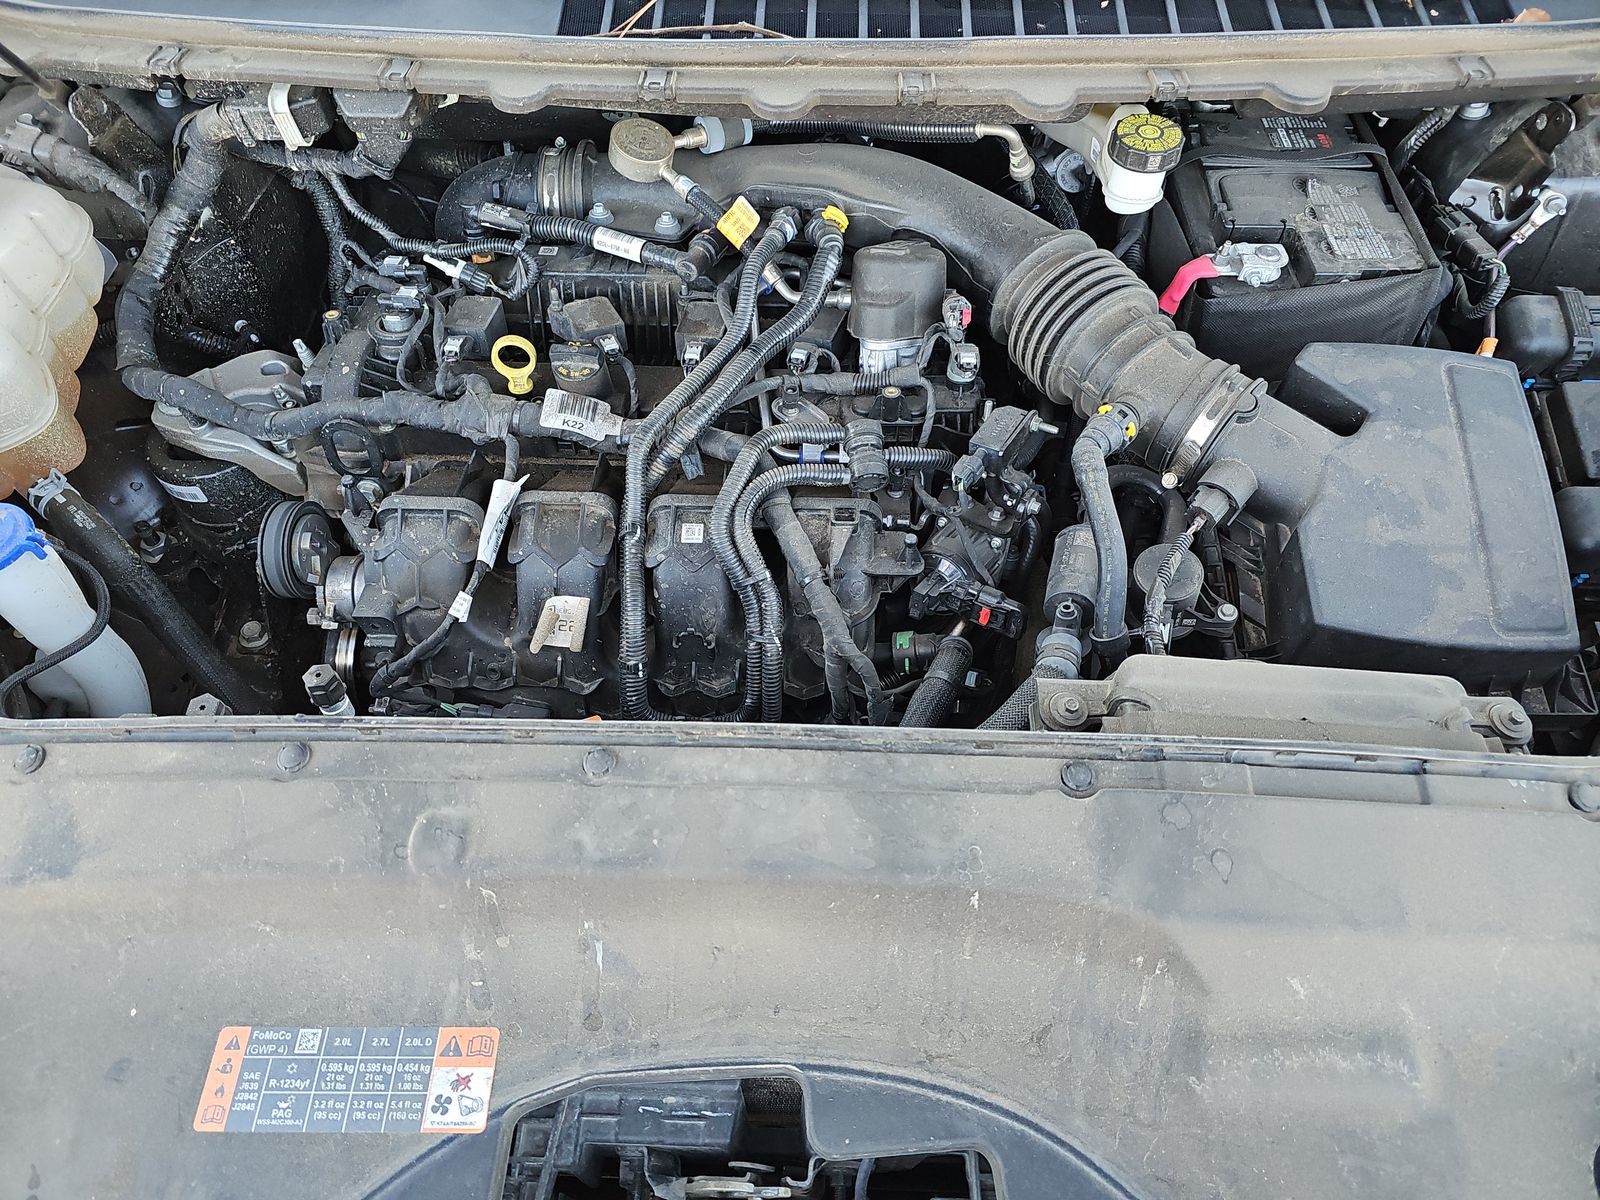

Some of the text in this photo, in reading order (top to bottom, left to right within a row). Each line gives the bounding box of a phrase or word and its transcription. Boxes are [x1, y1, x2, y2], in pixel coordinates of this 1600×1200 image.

[562, 418, 585, 431] K22
[252, 1030, 292, 1041] FoMoCo
[334, 1037, 352, 1046] 2.0L
[372, 1037, 390, 1046] 2.7L
[405, 1037, 432, 1046] 2.0L D
[246, 1044, 288, 1055] (GWP 4)
[321, 1063, 355, 1074] 0.595 kg
[359, 1063, 393, 1074] 0.595 kg
[397, 1063, 431, 1074] 0.454 kg
[243, 1072, 261, 1080] SAE
[269, 1079, 311, 1090] R-1234yf
[335, 1082, 347, 1090] lbs
[359, 1082, 385, 1090] 1.31 lbs
[412, 1082, 423, 1090] lbs
[271, 1109, 293, 1118] PAG
[313, 1111, 341, 1120] (95 cc)
[352, 1111, 380, 1120] (95 cc)
[408, 1111, 421, 1120] cc)
